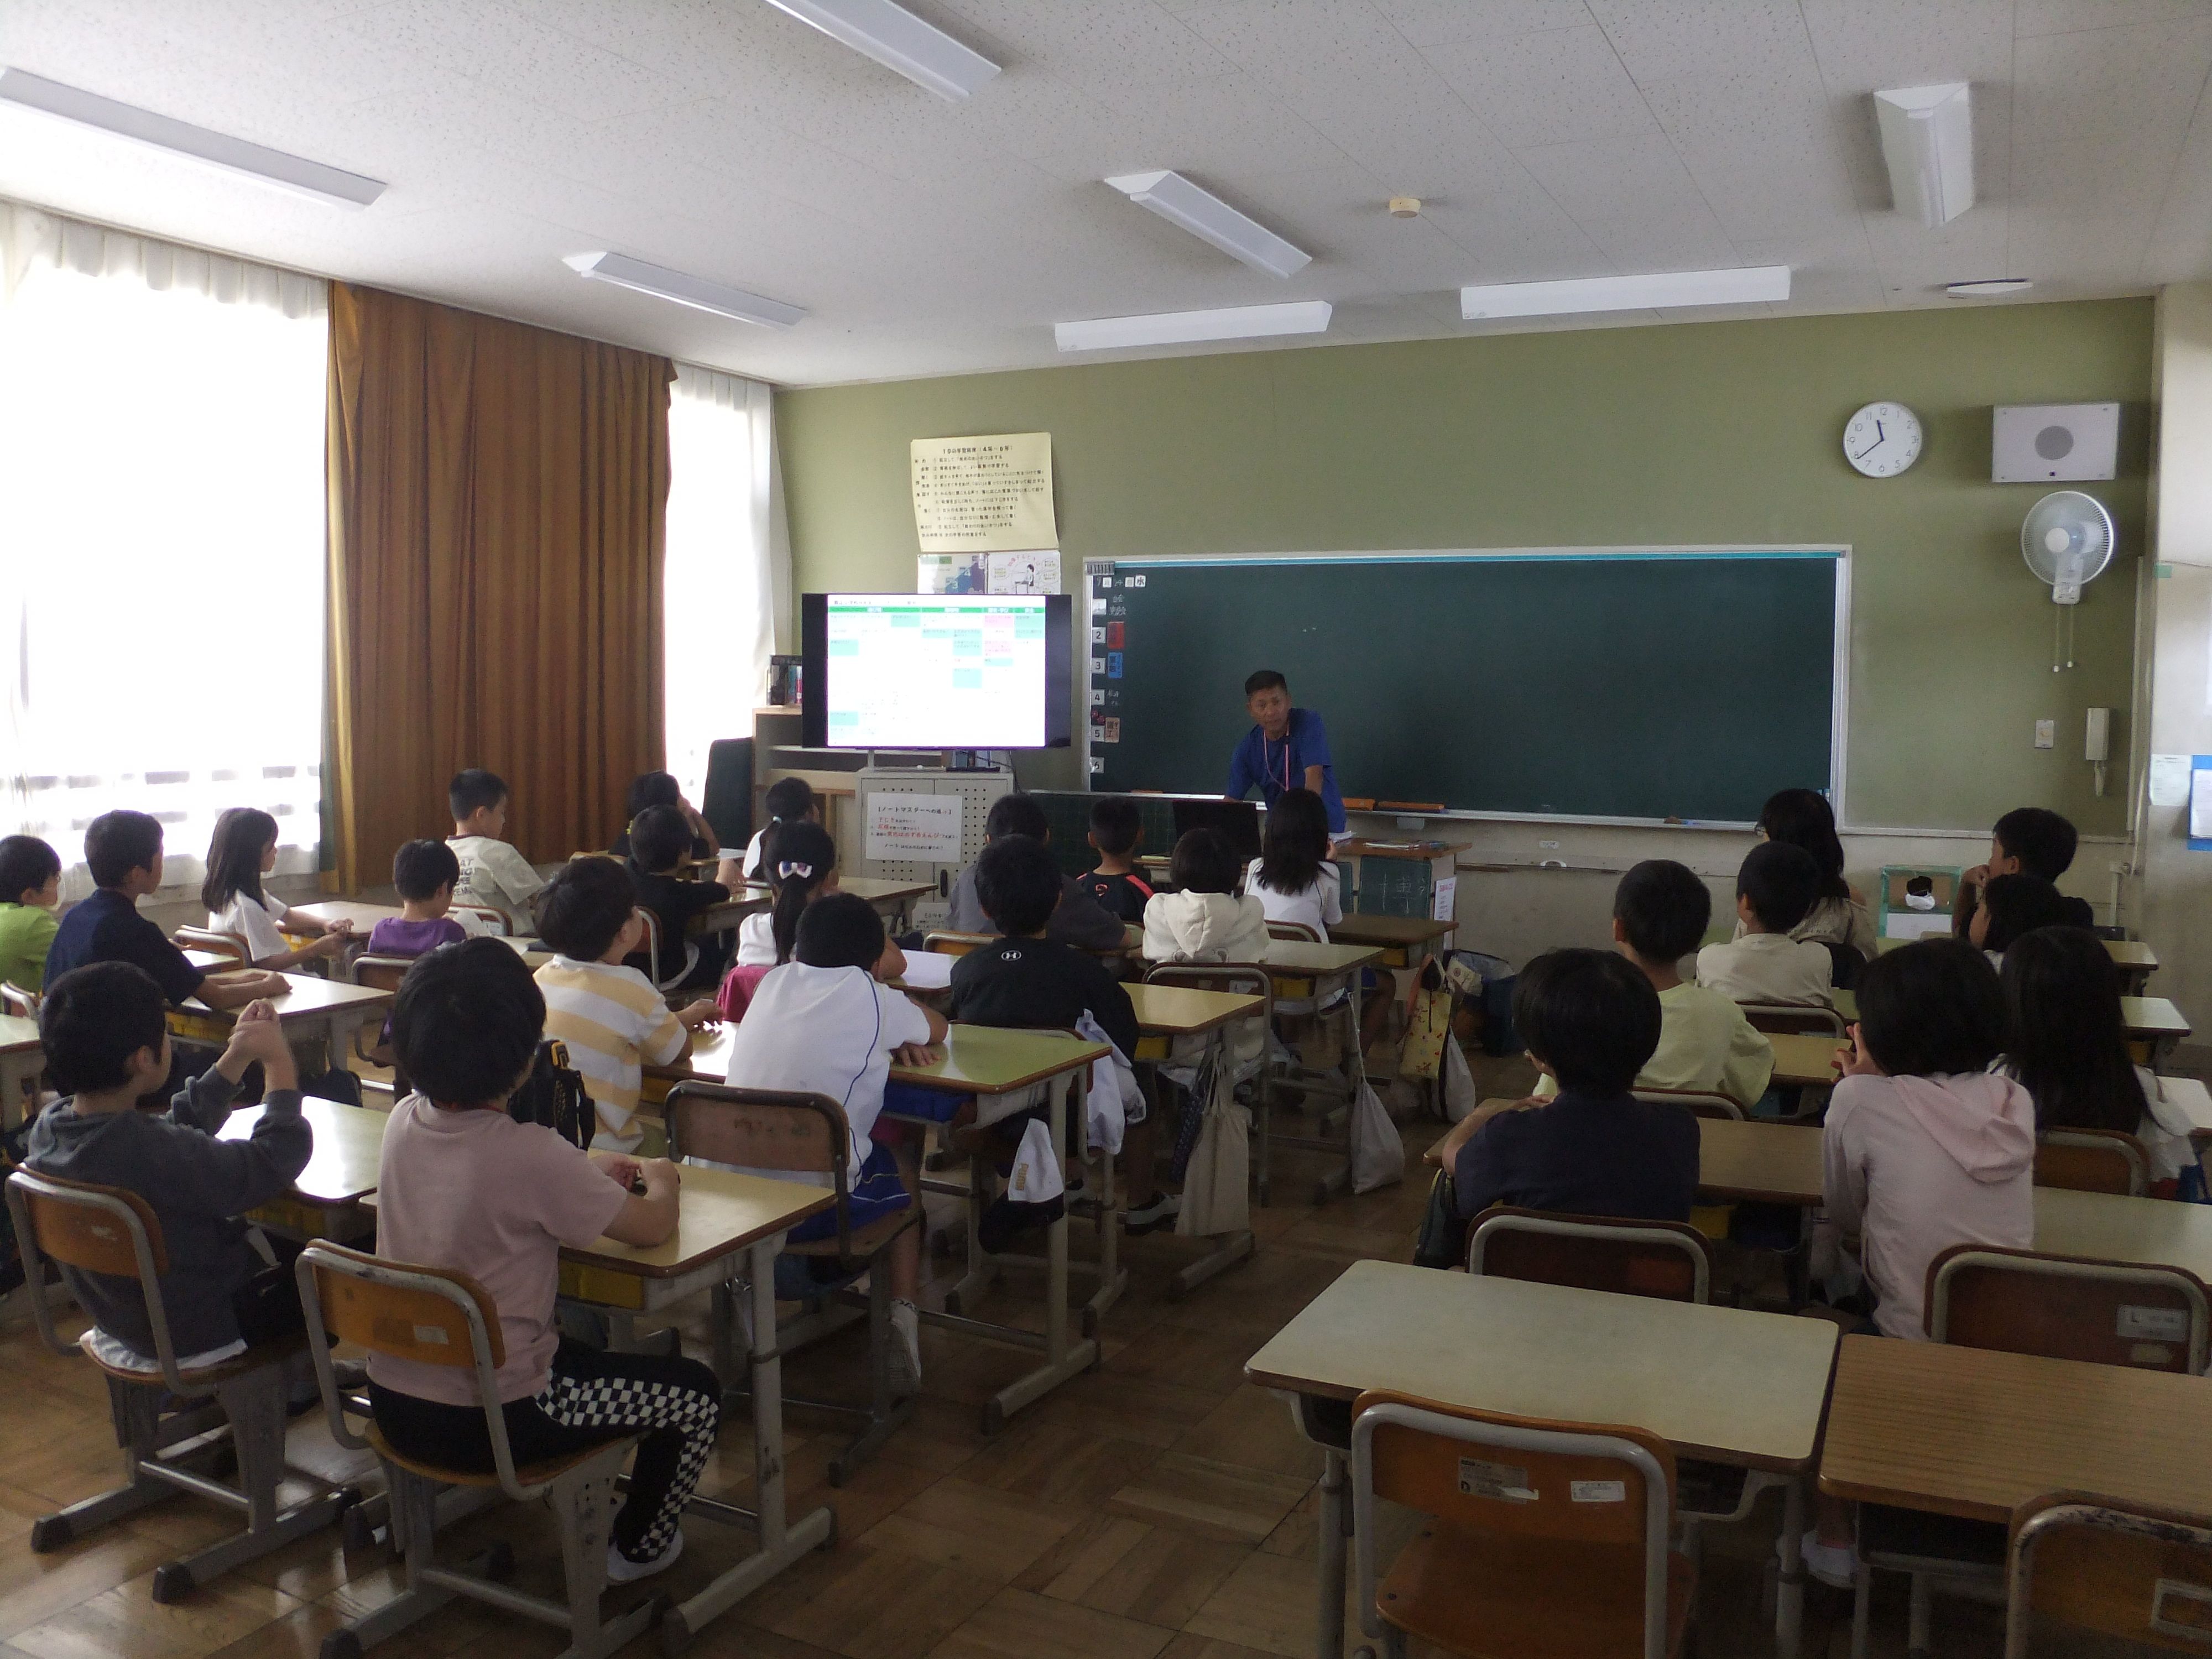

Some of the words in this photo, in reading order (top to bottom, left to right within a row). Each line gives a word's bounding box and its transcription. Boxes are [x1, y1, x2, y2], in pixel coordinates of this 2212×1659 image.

[1854, 423, 1863, 432] 10
[1907, 420, 1913, 429] 2
[1878, 463, 1885, 472] 6
[1895, 460, 1901, 468] 5
[1136, 576, 1145, 585] 水
[1096, 631, 1101, 639] 2
[1094, 729, 1100, 738] 5
